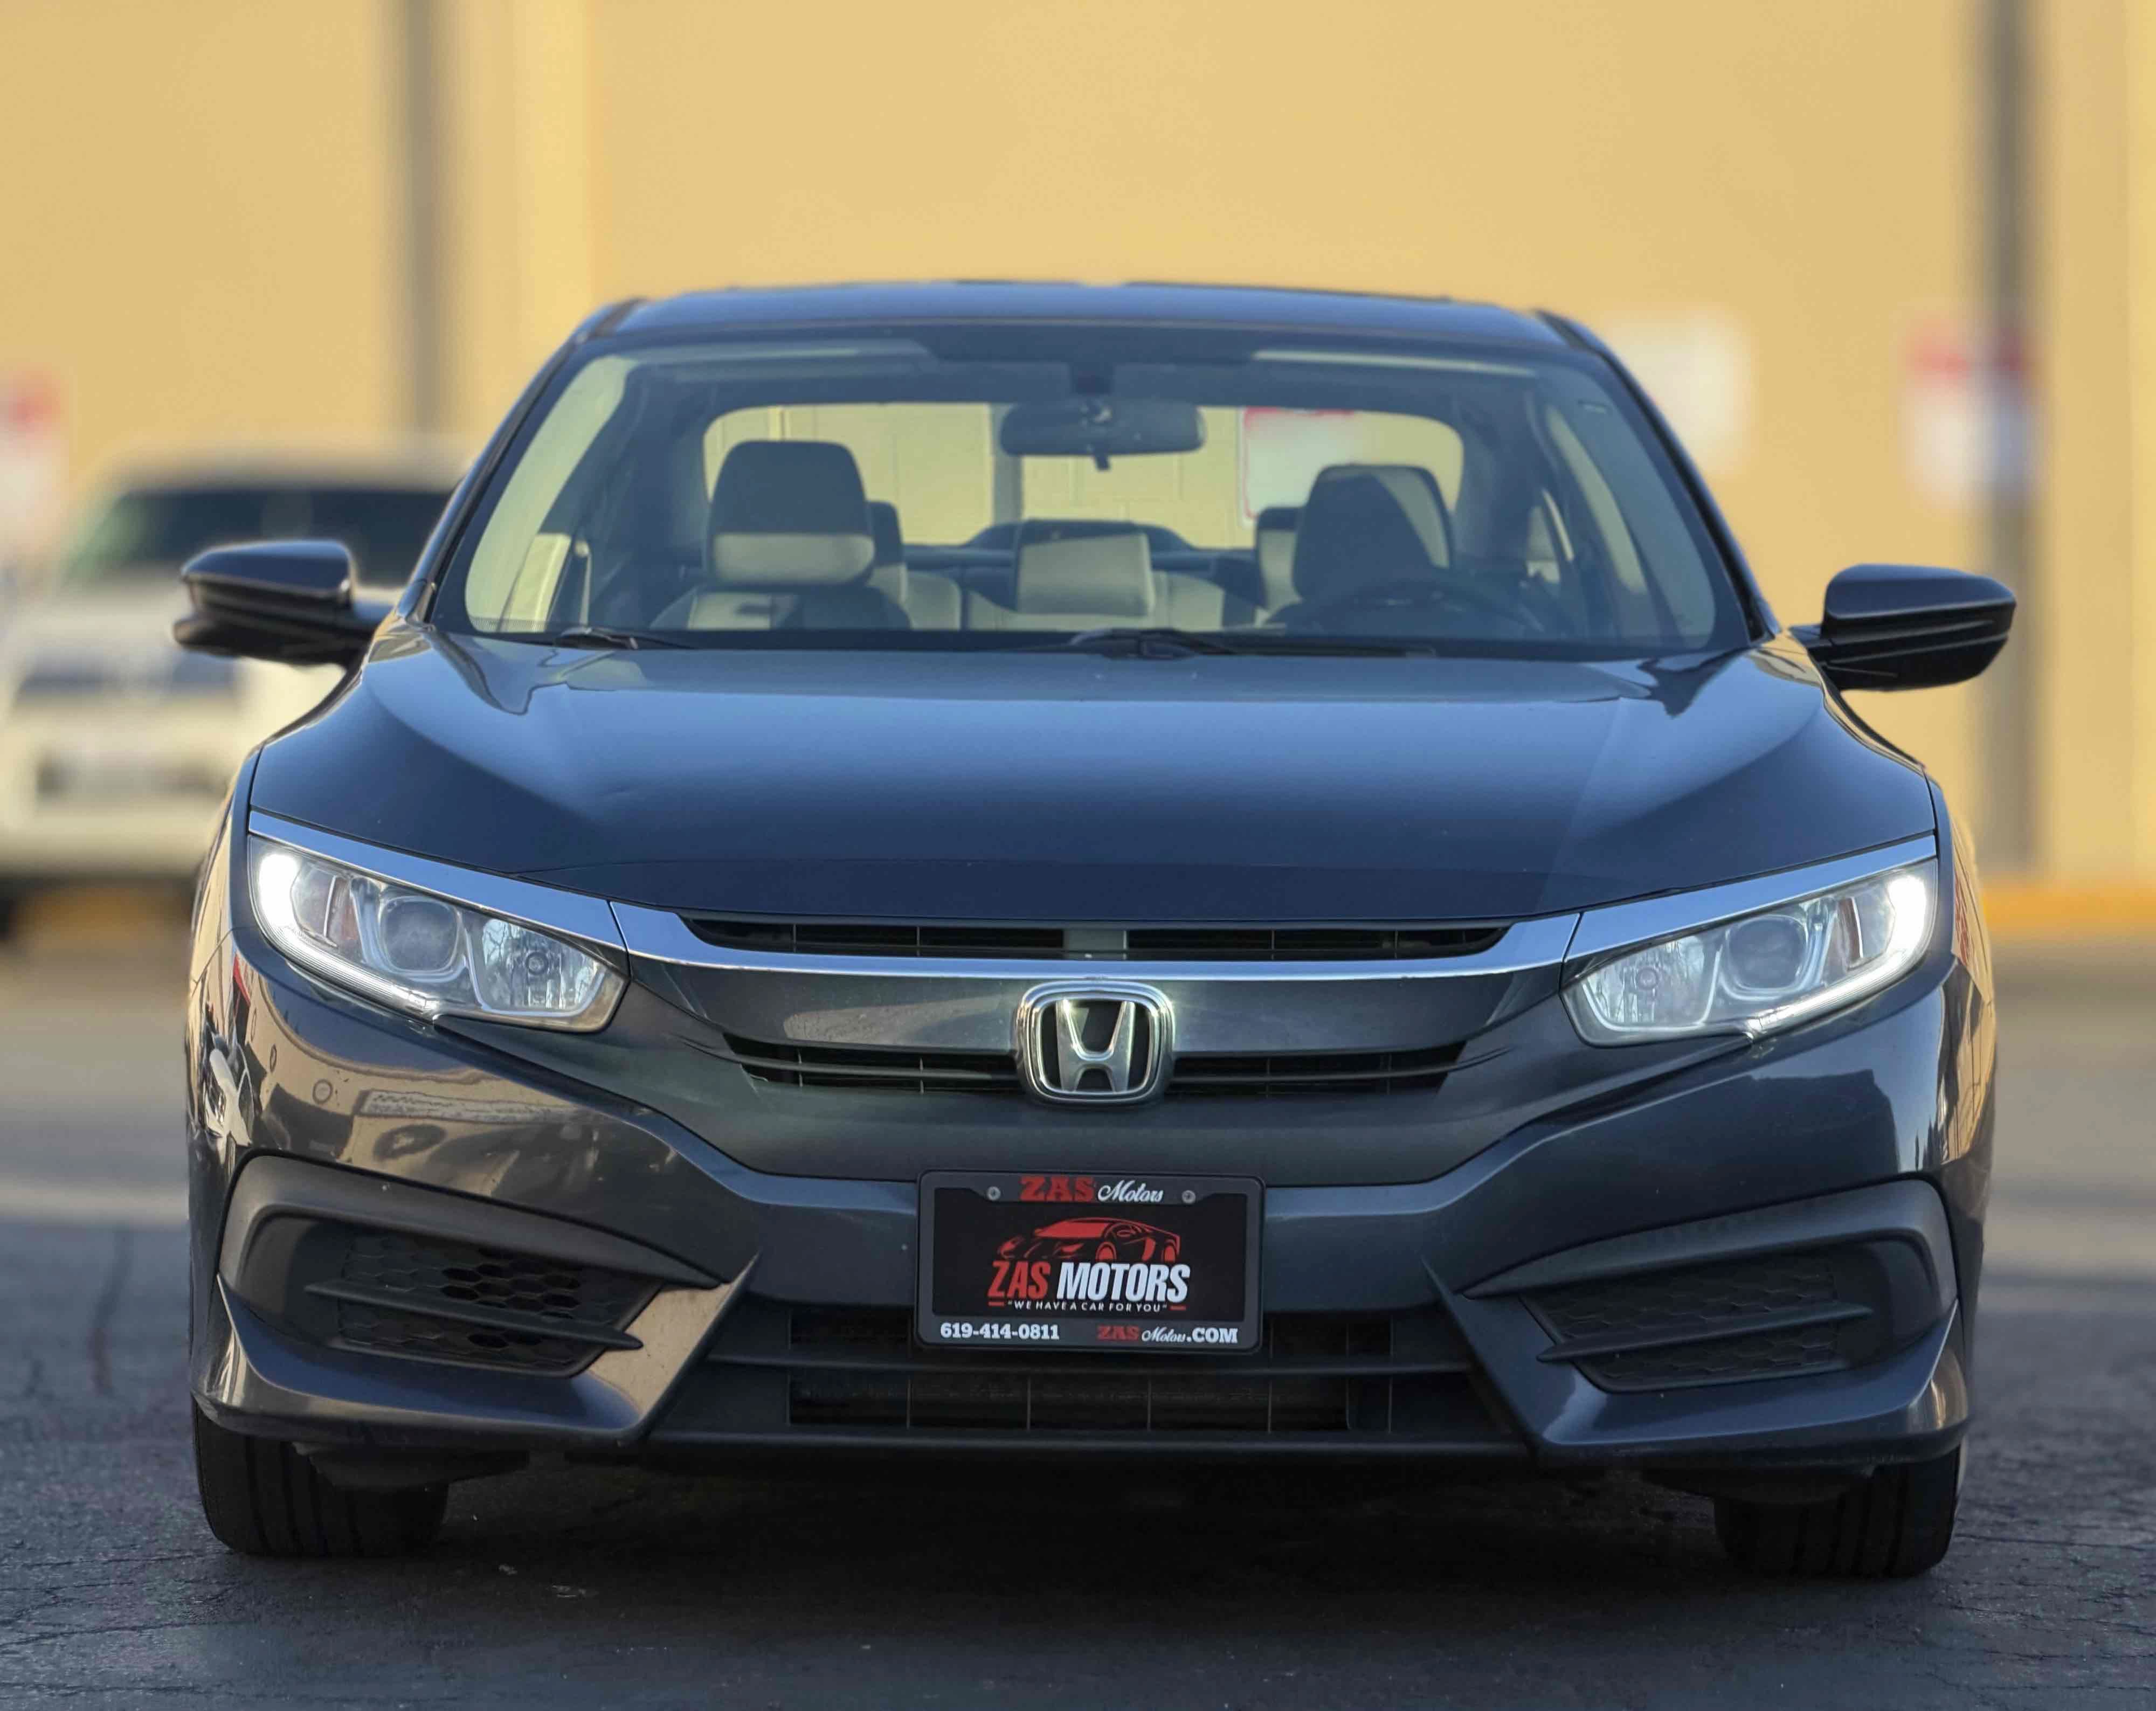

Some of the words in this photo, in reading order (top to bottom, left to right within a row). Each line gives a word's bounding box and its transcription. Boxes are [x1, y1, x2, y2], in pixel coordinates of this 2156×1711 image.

[1019, 1176, 1094, 1202] ZAS
[1097, 1179, 1164, 1203] Motors
[987, 1260, 1051, 1299] ZAS
[1056, 1262, 1191, 1303] MOTORS
[1035, 1301, 1066, 1311] HAVE
[1069, 1302, 1077, 1311] A
[1081, 1302, 1104, 1311] CAR
[1109, 1302, 1132, 1312] FOR
[940, 1322, 1060, 1341] 619-414-0811
[1098, 1325, 1139, 1341] ZAS
